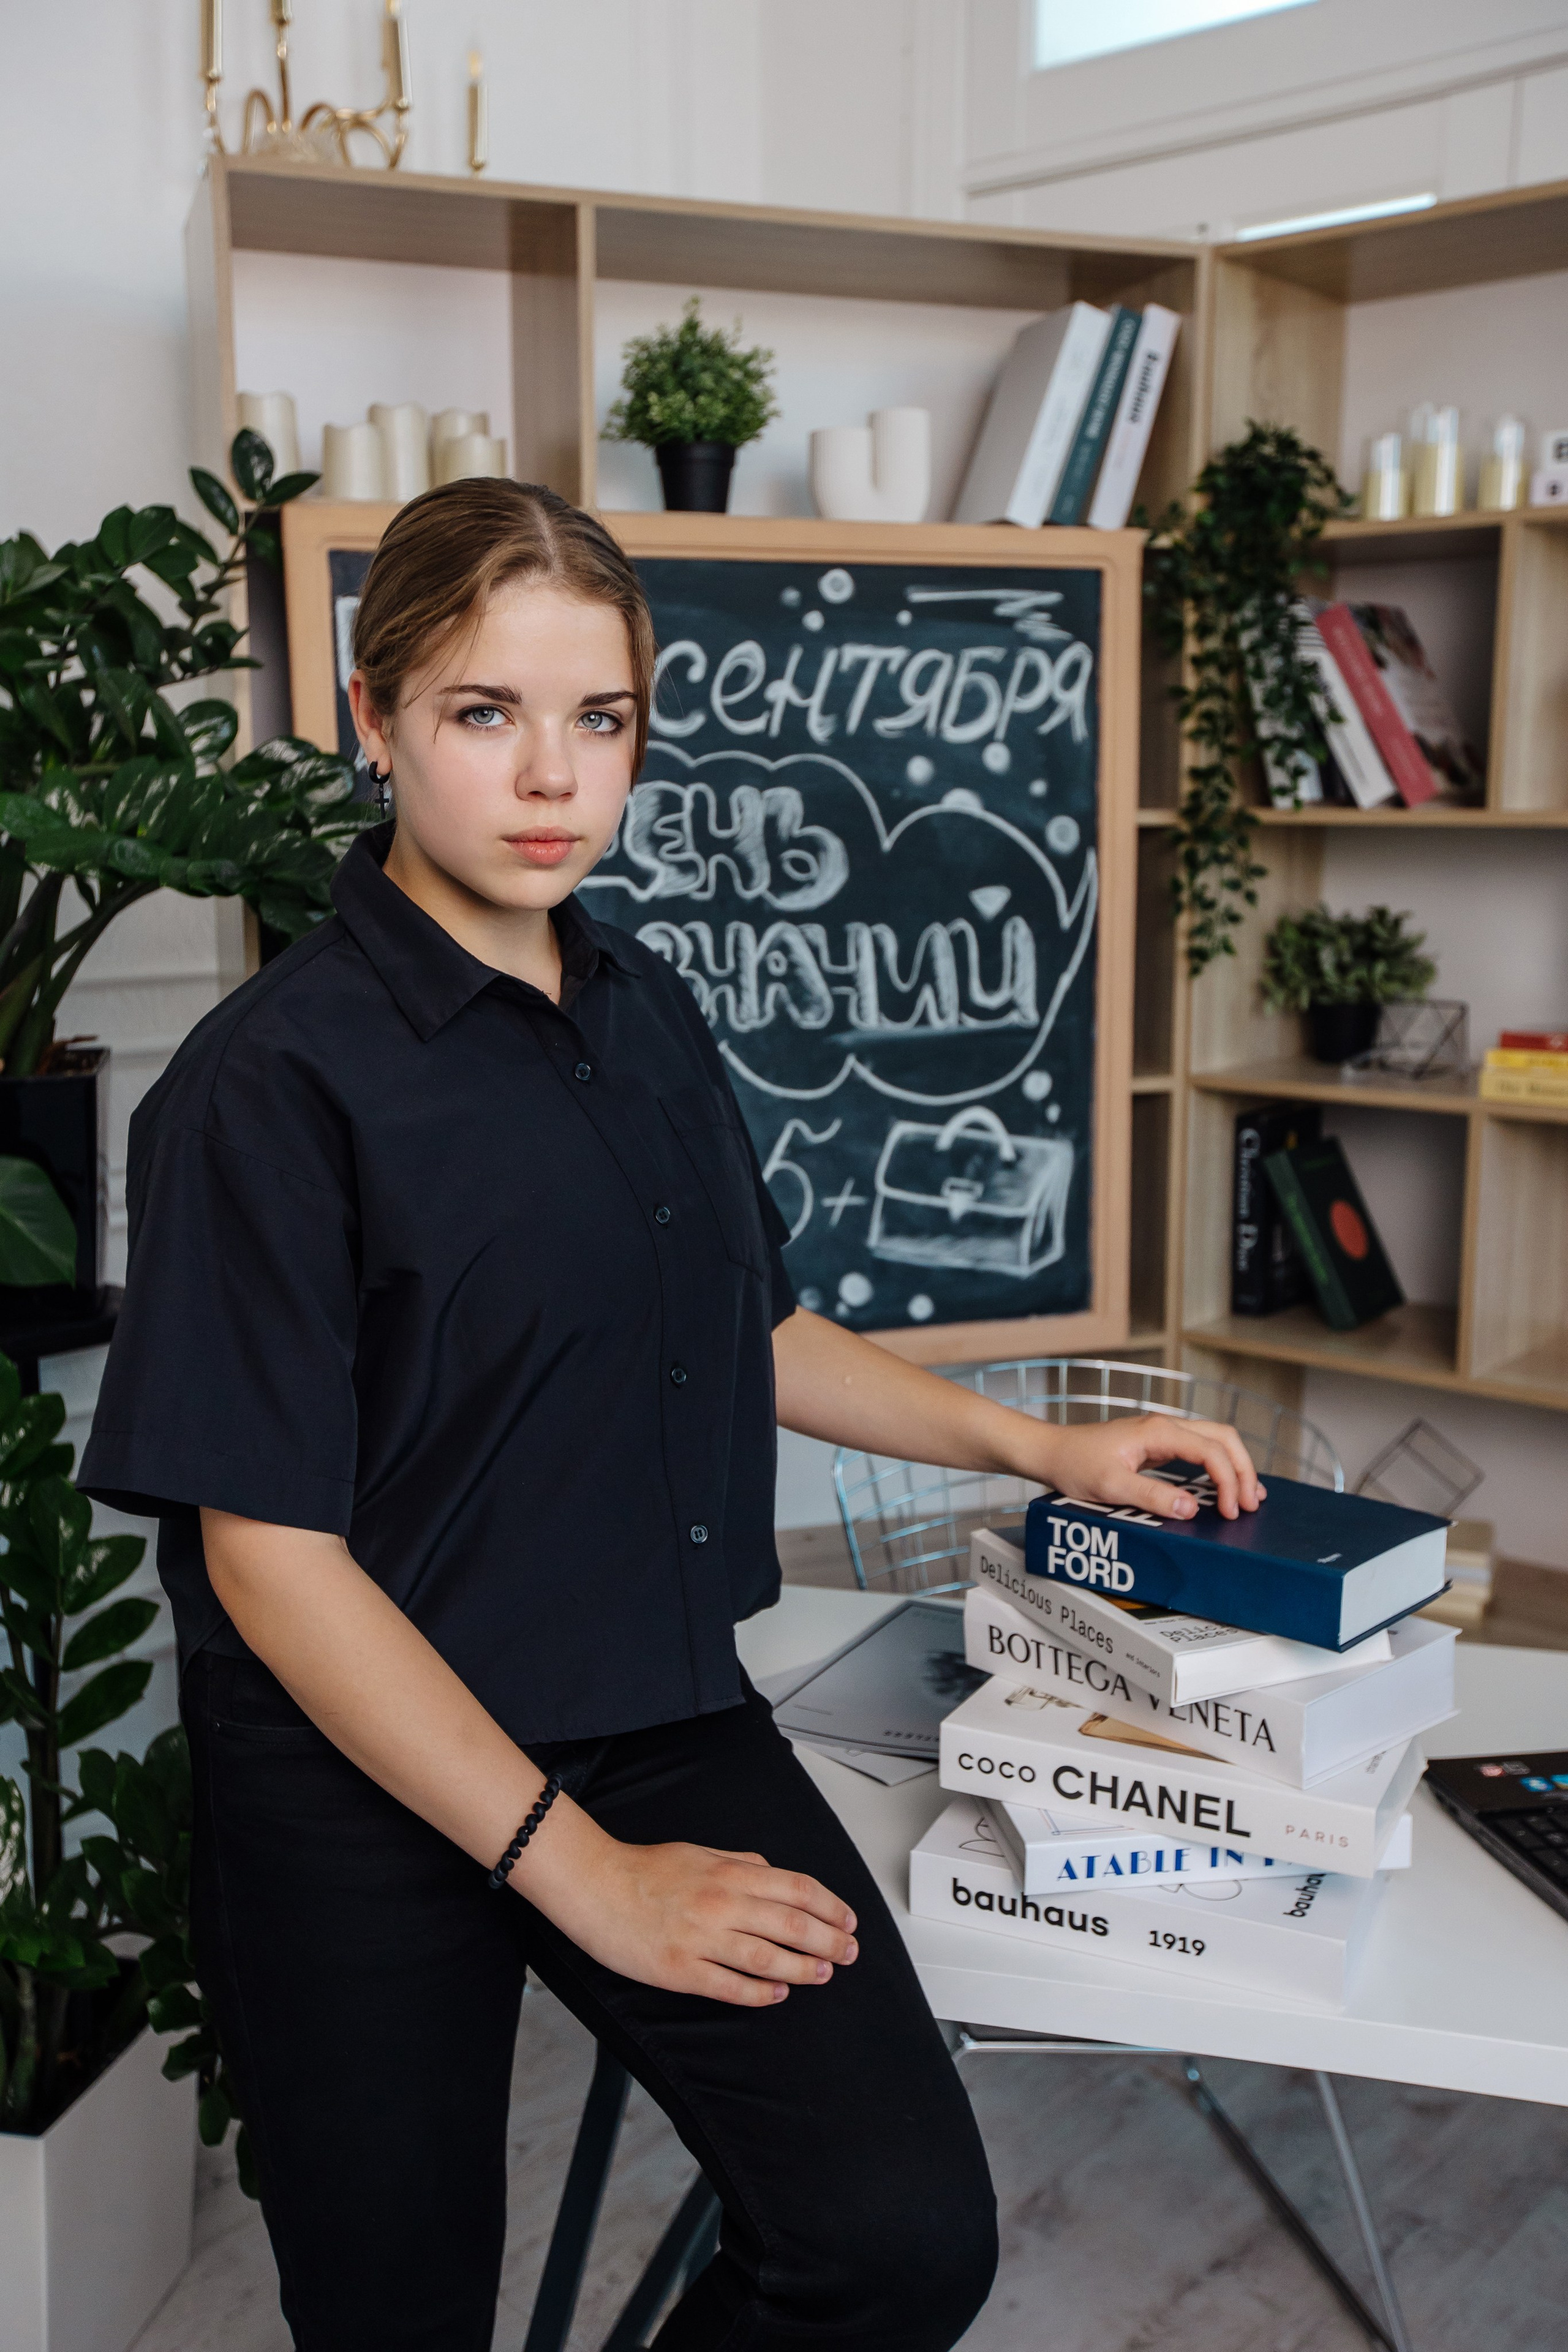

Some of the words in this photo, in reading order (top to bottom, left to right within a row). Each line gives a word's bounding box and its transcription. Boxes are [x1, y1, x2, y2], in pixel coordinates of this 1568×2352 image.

[576, 780, 850, 911] ЕНЬ
[1047, 1516, 1118, 1561] TOM
[1048, 1545, 1135, 1592] FORD
[981, 1555, 1052, 1615] Delicious
[1060, 1605, 1114, 1654] Places
[987, 1623, 1133, 1702] BOTTEGA
[1052, 1765, 1251, 1839] CHANEL
[1285, 1824, 1349, 1849] PARIS
[952, 1877, 1110, 1937] bauhaus
[1148, 1929, 1207, 1957] 1919
[1283, 1873, 1327, 1918] bauha
